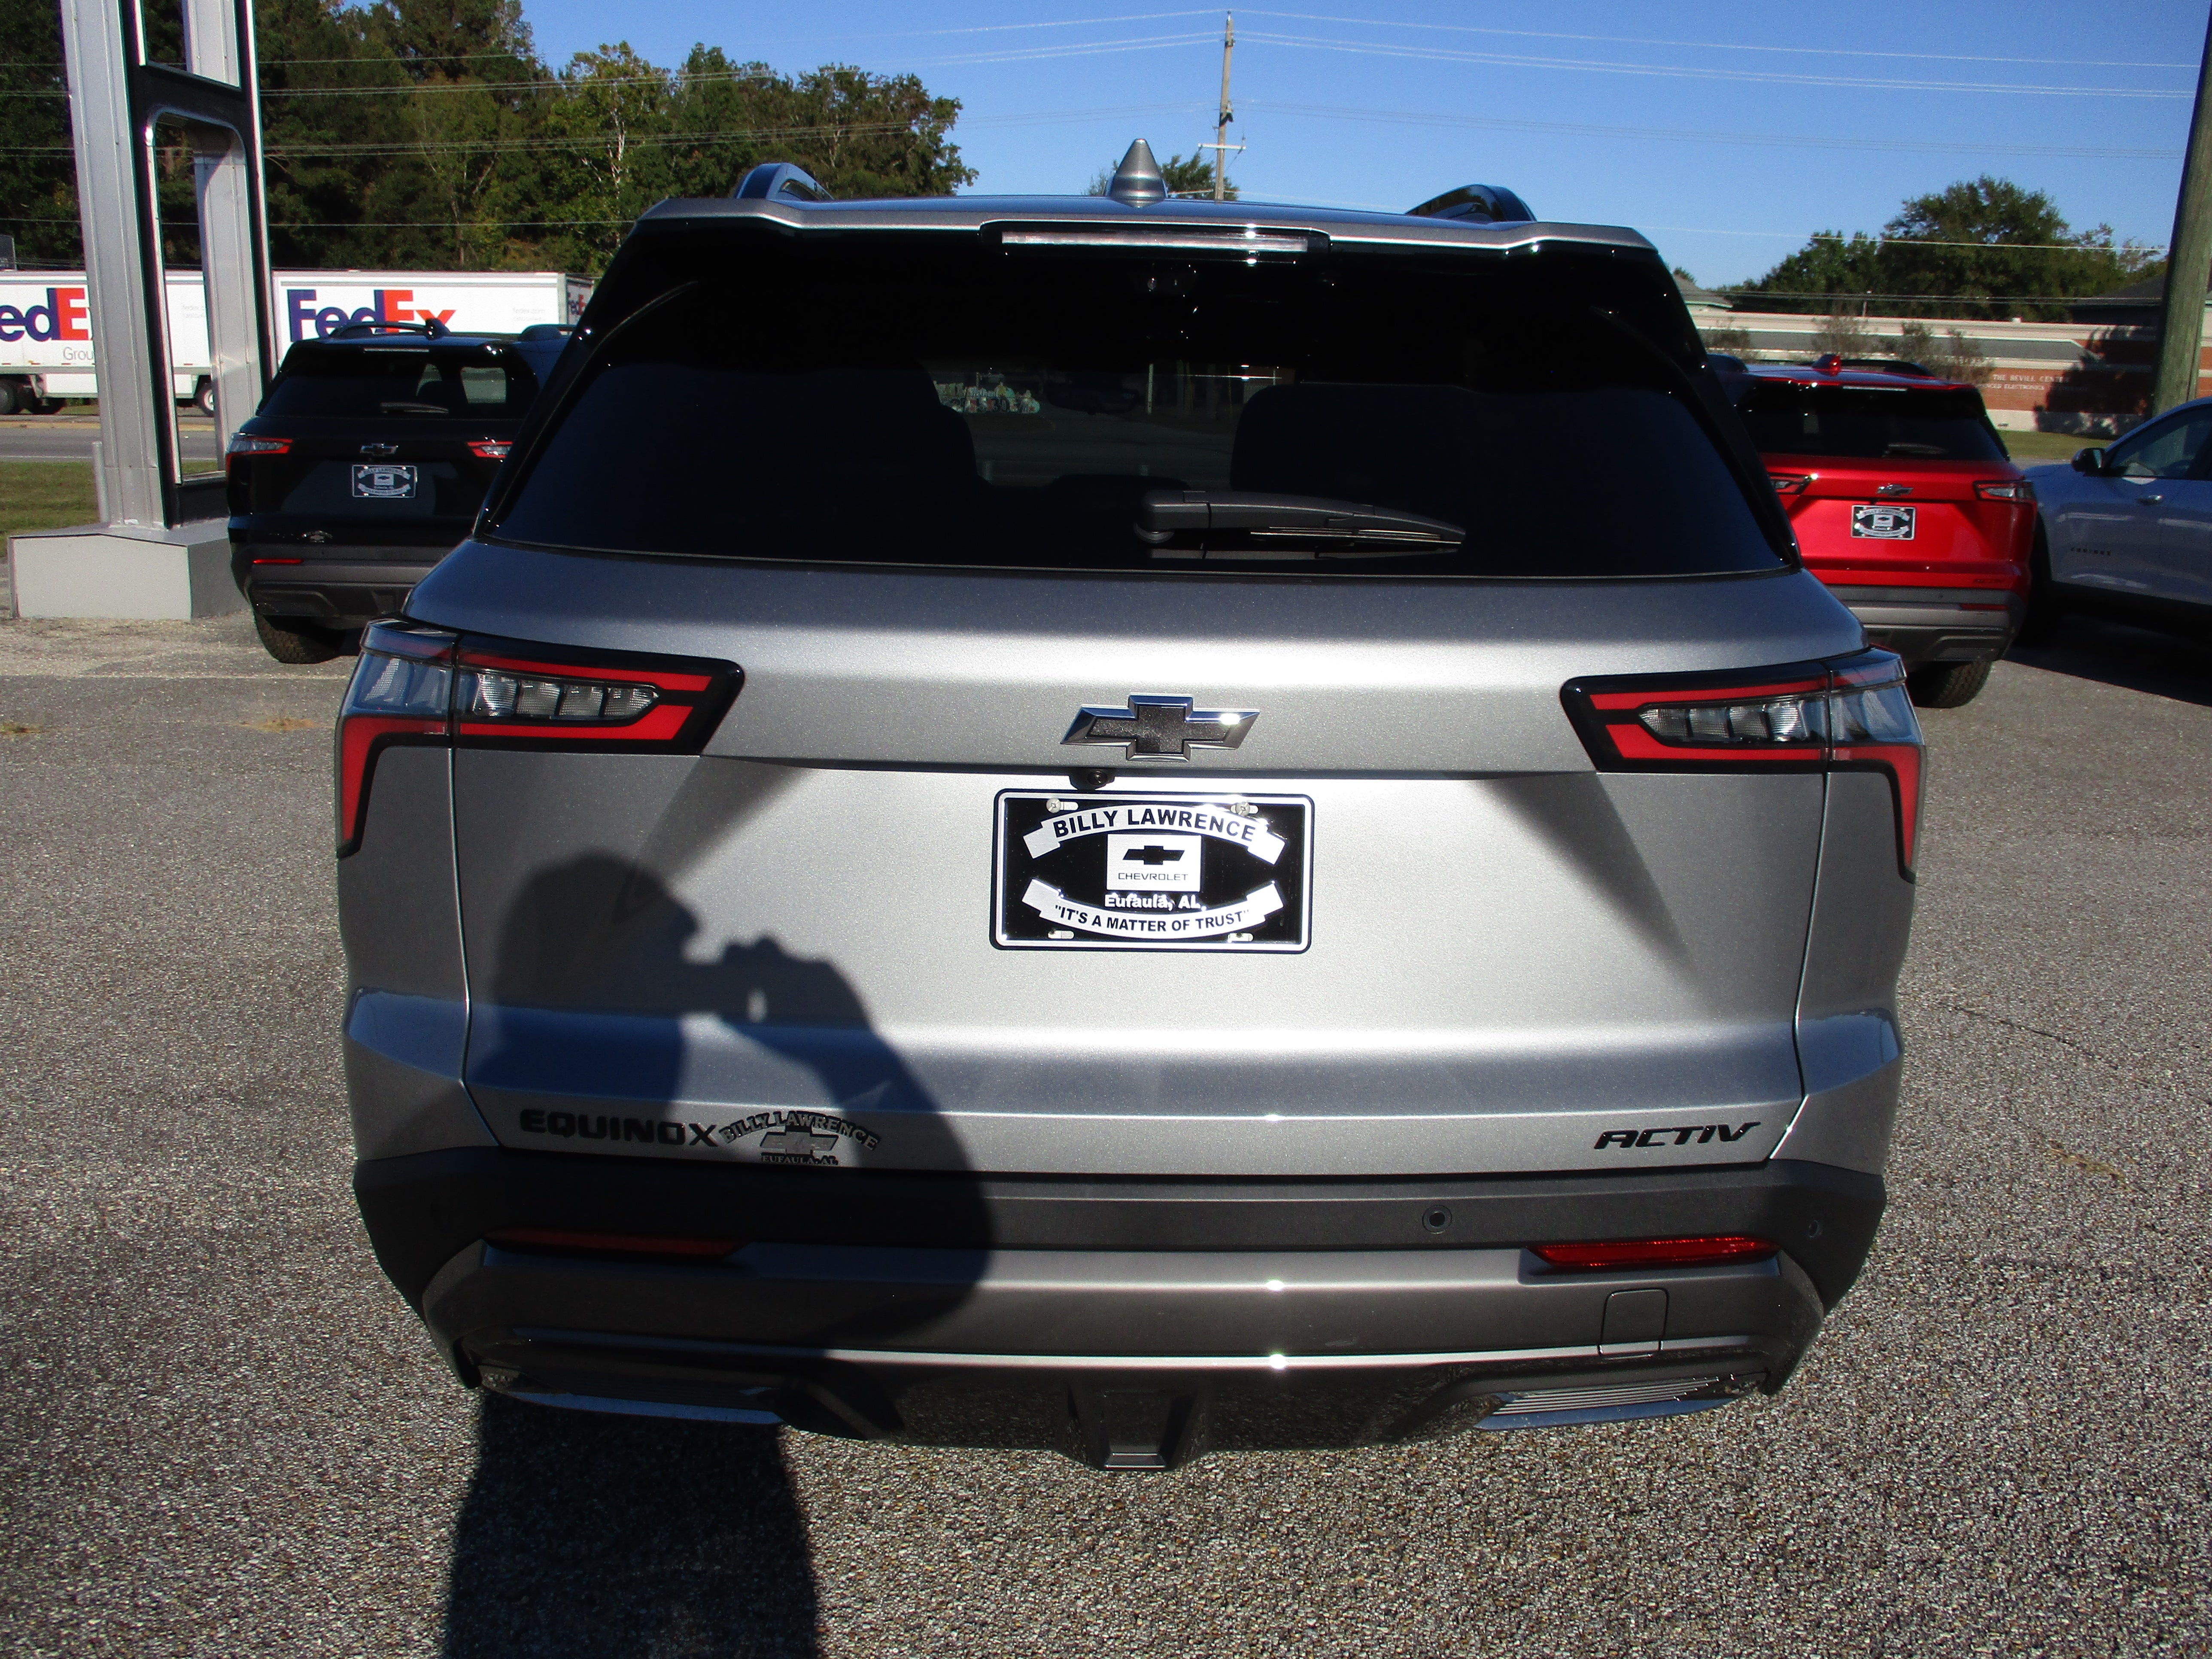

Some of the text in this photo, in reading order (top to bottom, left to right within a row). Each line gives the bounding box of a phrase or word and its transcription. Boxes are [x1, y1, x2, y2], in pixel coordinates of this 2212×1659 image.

[0, 288, 92, 342] edE
[287, 289, 456, 342] FedEx
[1053, 808, 1256, 842] BILLY LAWRENCE
[1118, 872, 1188, 881] CHEVROLET
[1054, 905, 1249, 932] "IT'S A MATTER OF TRUST"
[1105, 893, 1173, 911] Eufaula,
[520, 1109, 719, 1147] EQUINOX
[719, 1110, 881, 1151] BILLY LAWRENCE
[1593, 1121, 1761, 1149] ACTIV
